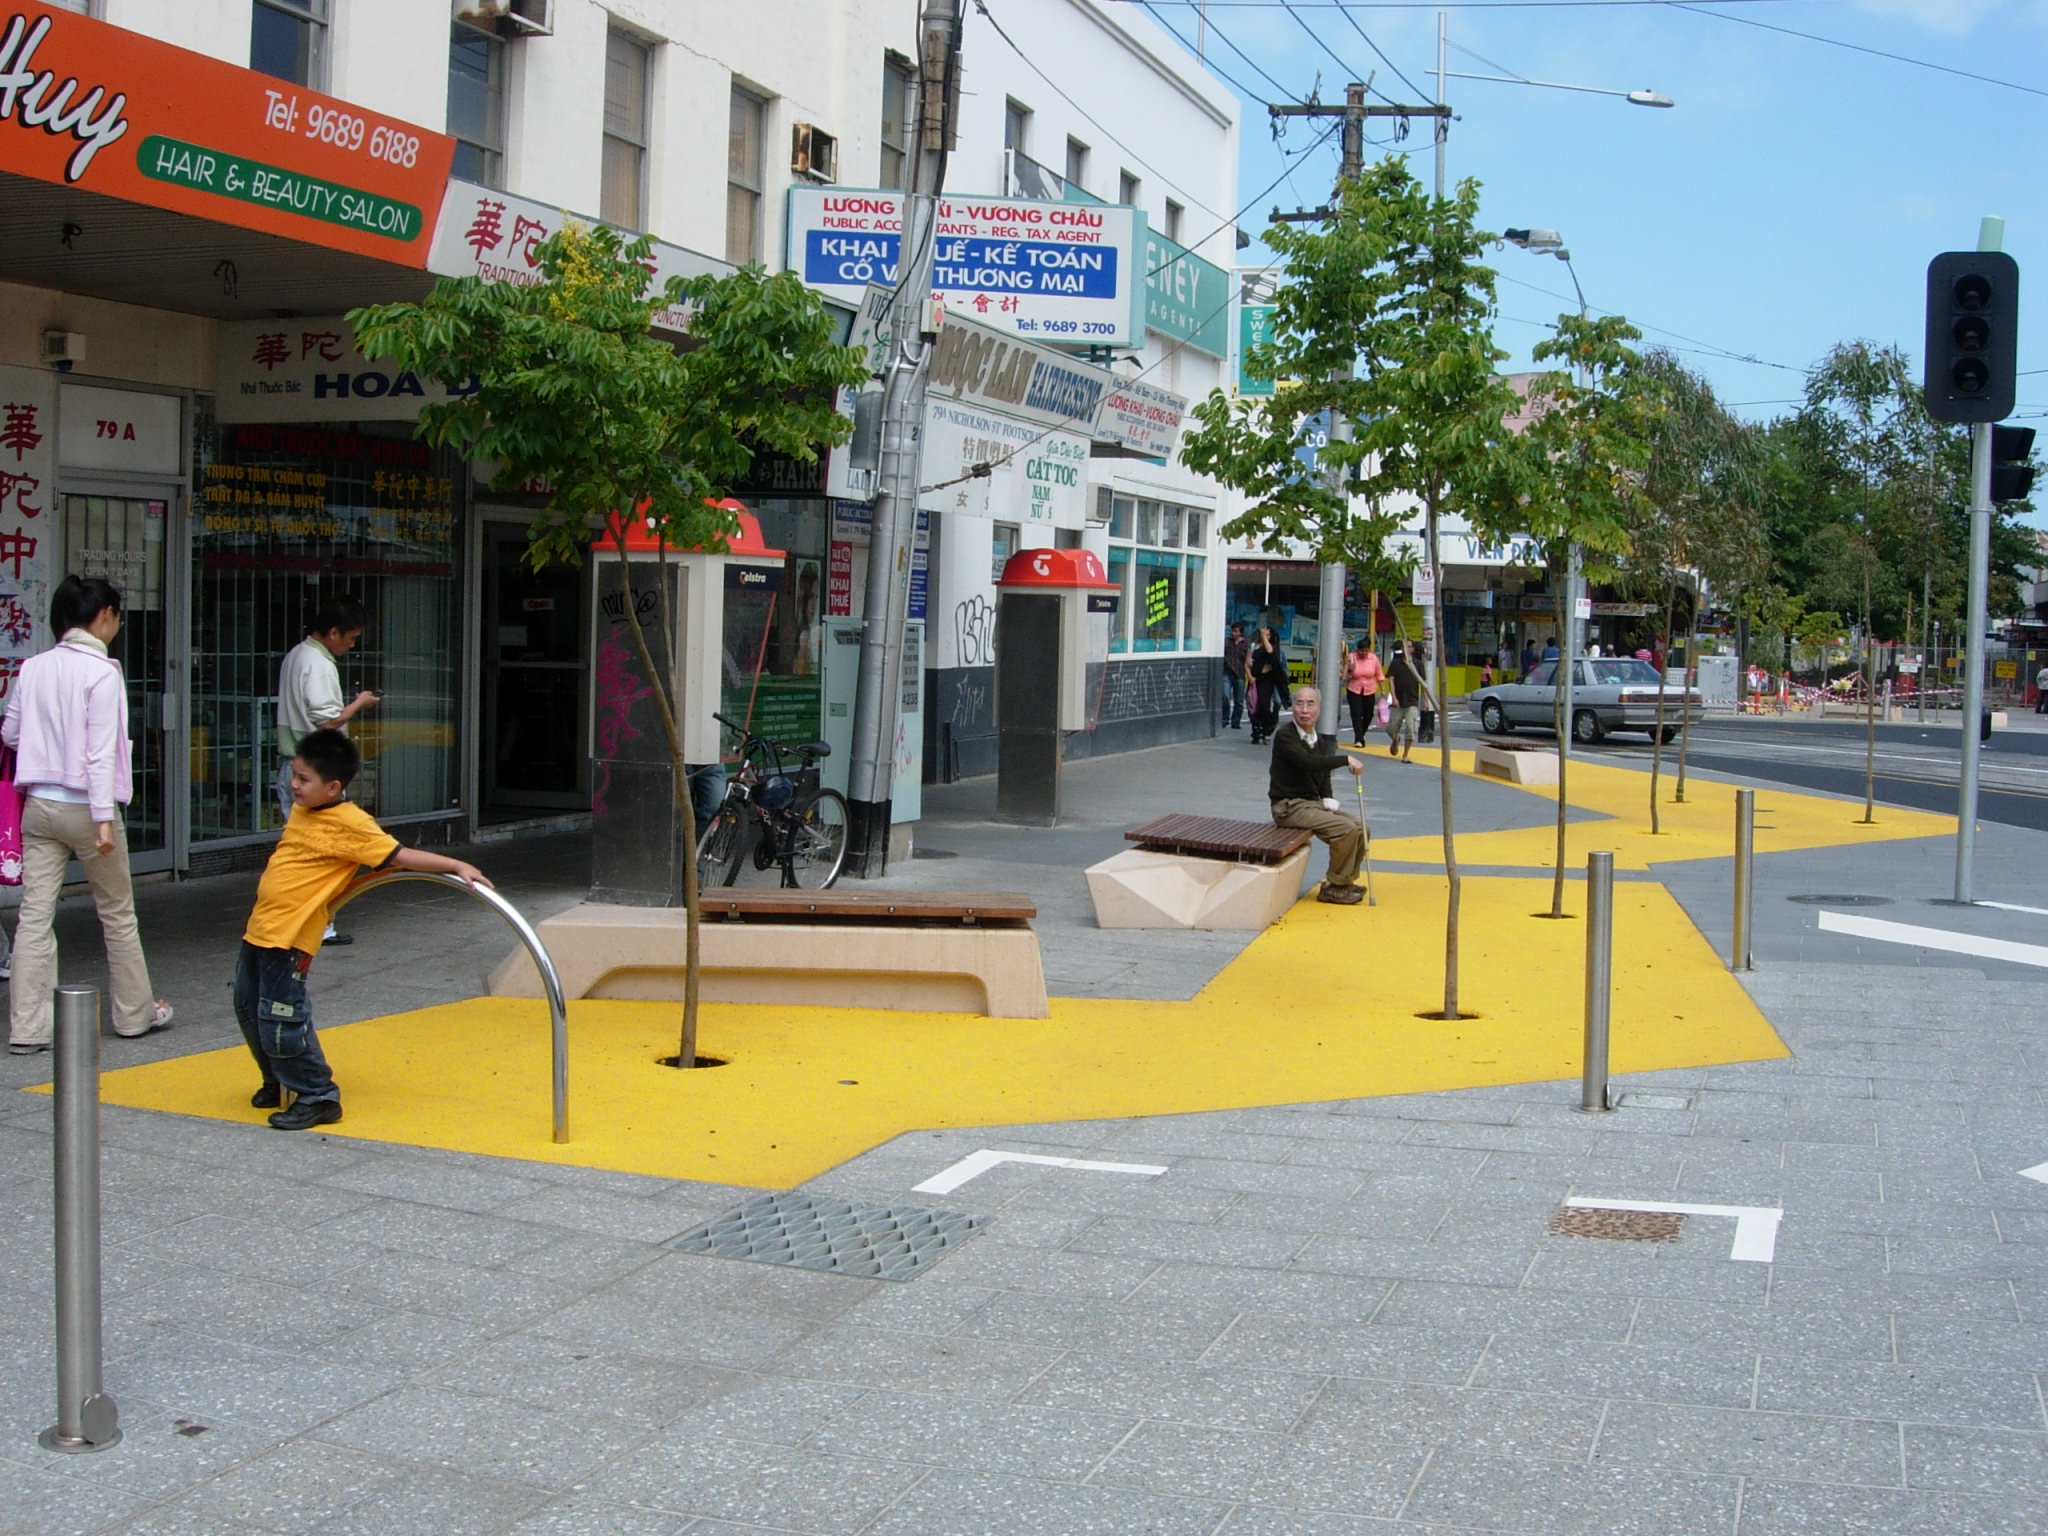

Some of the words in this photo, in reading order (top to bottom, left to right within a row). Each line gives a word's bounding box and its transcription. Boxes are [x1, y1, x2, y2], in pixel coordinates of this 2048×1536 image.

[0, 14, 128, 182] Huy
[265, 89, 299, 133] Tel:
[305, 105, 365, 151] 9689
[370, 126, 420, 169] 6188
[156, 145, 215, 186] HAIR
[225, 164, 245, 192] &
[252, 170, 338, 215] BEAUTY
[339, 196, 410, 235] SALON
[823, 197, 895, 215] LƯƠNG
[967, 204, 1042, 223] VƯƠNG
[1050, 209, 1103, 227] CHÂU
[823, 218, 868, 229] PUBLIC
[873, 220, 977, 235] ACCTANTS
[991, 227, 1020, 238] REG.
[1026, 228, 1051, 240] TAX
[1056, 230, 1102, 243] AGENT
[821, 238, 888, 258] KHAI
[1026, 246, 1102, 271] TOÁN
[935, 265, 1033, 289] THƯƠNG
[1016, 319, 1038, 331] Tel:
[1043, 320, 1077, 334] 9689
[1082, 322, 1115, 335] 3700
[97, 420, 118, 439] 79
[122, 424, 136, 441] A
[947, 410, 990, 434] NICHOLSON
[991, 421, 1002, 434] ST
[1002, 423, 1041, 445] FOOTSCRAY
[1032, 485, 1051, 501] NAM
[79, 549, 116, 561] TRADING
[118, 551, 147, 562] HOURS
[85, 566, 108, 576] OPEN
[739, 571, 767, 584] Telstra
[831, 578, 850, 591] KHAI
